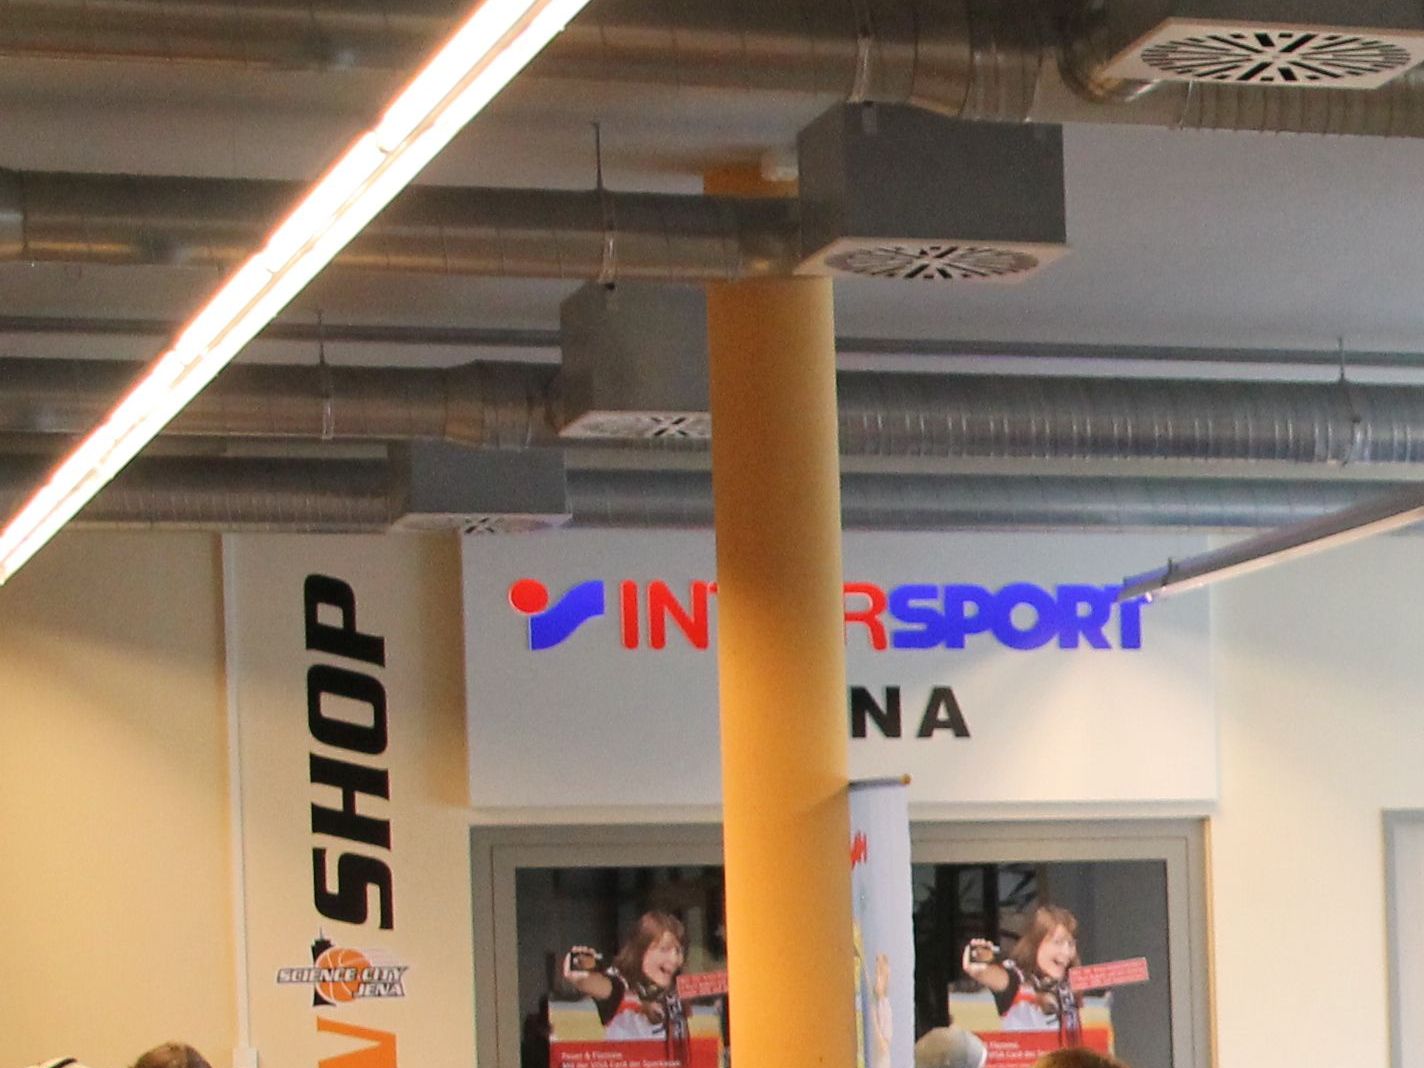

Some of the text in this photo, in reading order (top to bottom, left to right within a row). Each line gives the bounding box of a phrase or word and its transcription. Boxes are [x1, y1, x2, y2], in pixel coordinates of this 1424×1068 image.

[619, 578, 1150, 650] INRSPORT
[850, 686, 970, 738] NA
[304, 574, 394, 930] SHOP
[278, 966, 408, 983] SCIENCE CITY
[354, 982, 405, 998] JENA
